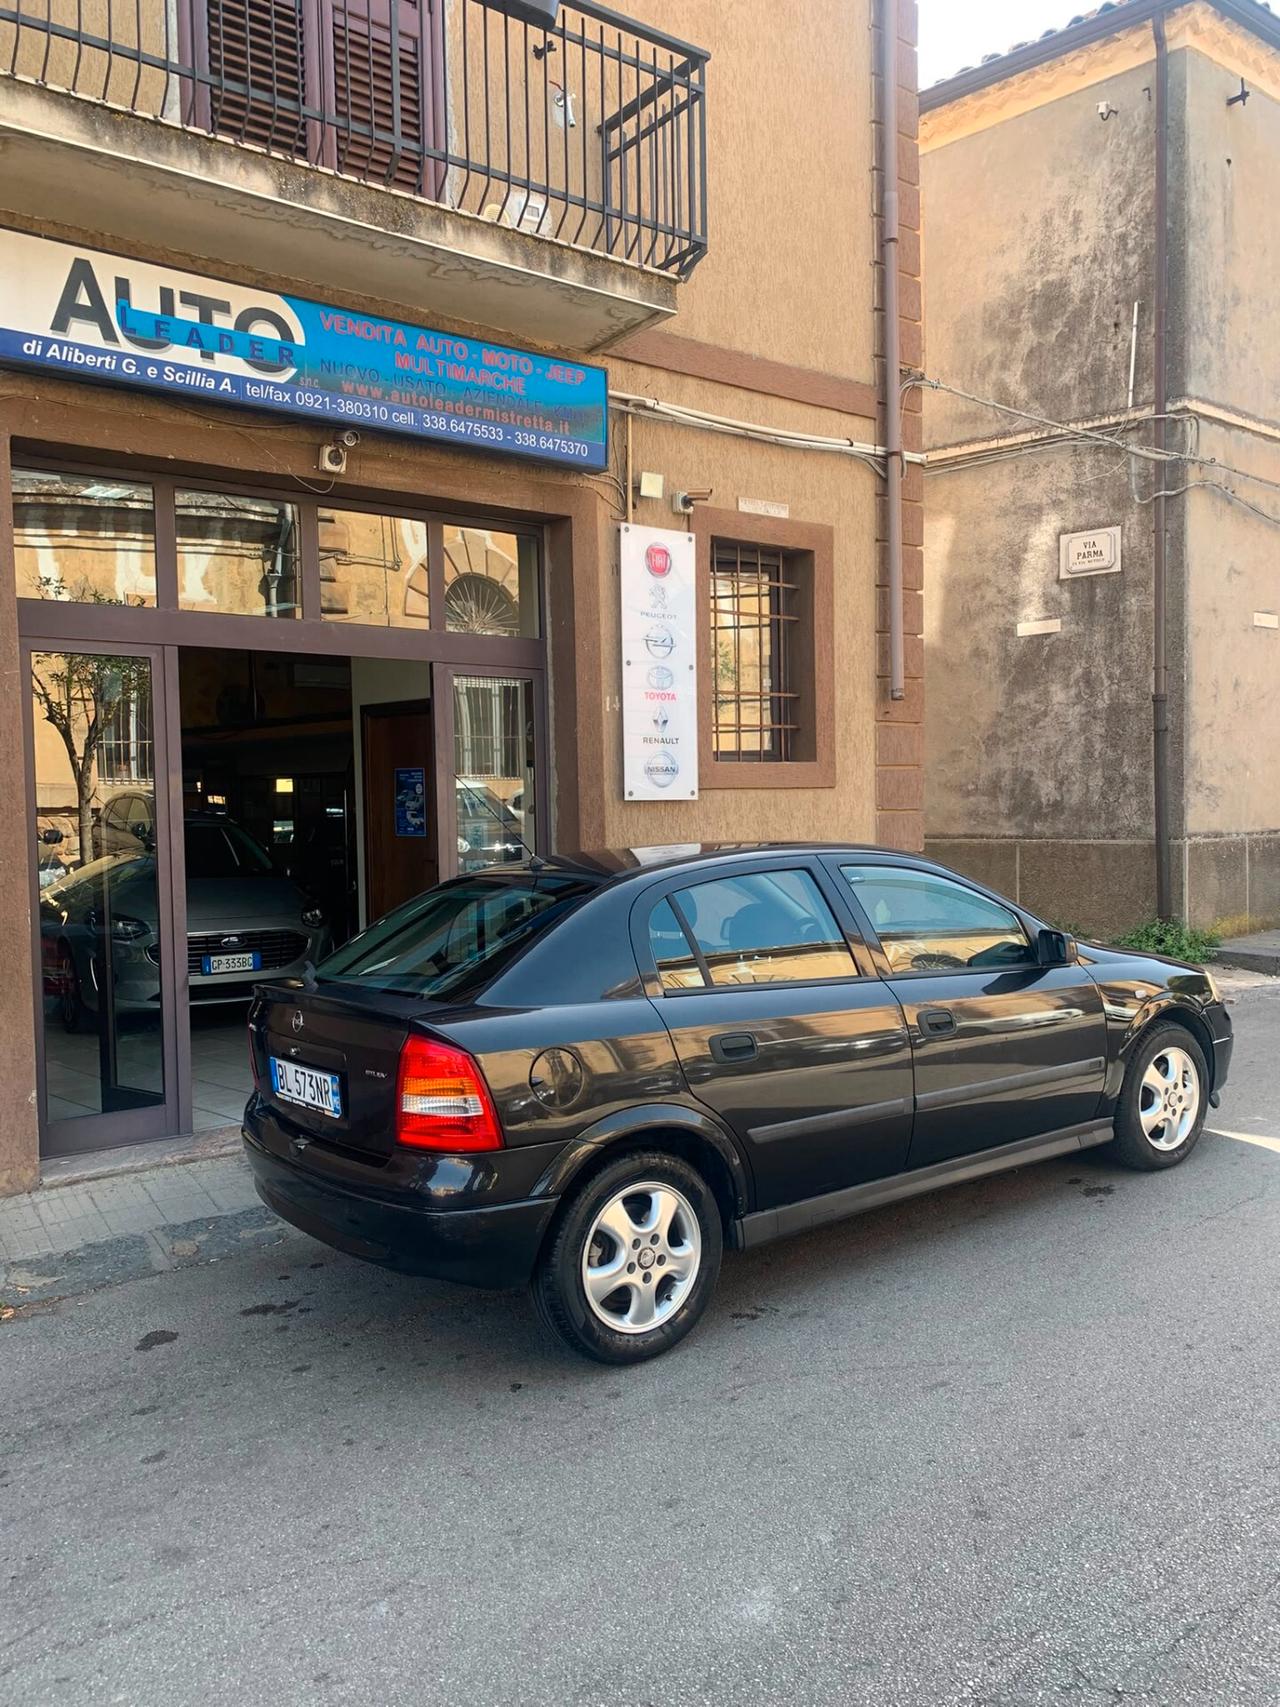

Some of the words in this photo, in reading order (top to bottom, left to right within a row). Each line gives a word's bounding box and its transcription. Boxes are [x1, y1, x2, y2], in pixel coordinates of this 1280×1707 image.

[50, 257, 297, 374] AUTO
[120, 305, 297, 368] LEADER
[319, 310, 408, 347] VENDITA
[416, 333, 469, 361] AUTO
[482, 349, 533, 375] MOTO
[546, 364, 585, 386] JEEP
[320, 358, 380, 383] NUOVO
[393, 373, 446, 396] USATO
[395, 352, 526, 395] MULTIMARCHE
[23, 340, 41, 356] di
[46, 344, 117, 370] Aliberti
[122, 358, 141, 375] G.
[147, 365, 158, 377] e
[163, 367, 216, 390] Scillia
[219, 378, 237, 394] A.
[246, 382, 292, 404] tel/fax
[296, 391, 388, 421] 0921-380310
[392, 411, 418, 426] cell.
[423, 414, 503, 441] 338.6475533
[514, 431, 589, 458] 338.6475370
[341, 380, 571, 435] www.autoleadermistretta.it
[1076, 550, 1104, 560] PARMA
[1083, 541, 1097, 549] VIA
[640, 611, 677, 620] PEUGEOT
[644, 692, 677, 701] TOYOTA
[642, 736, 680, 745] RENAULT
